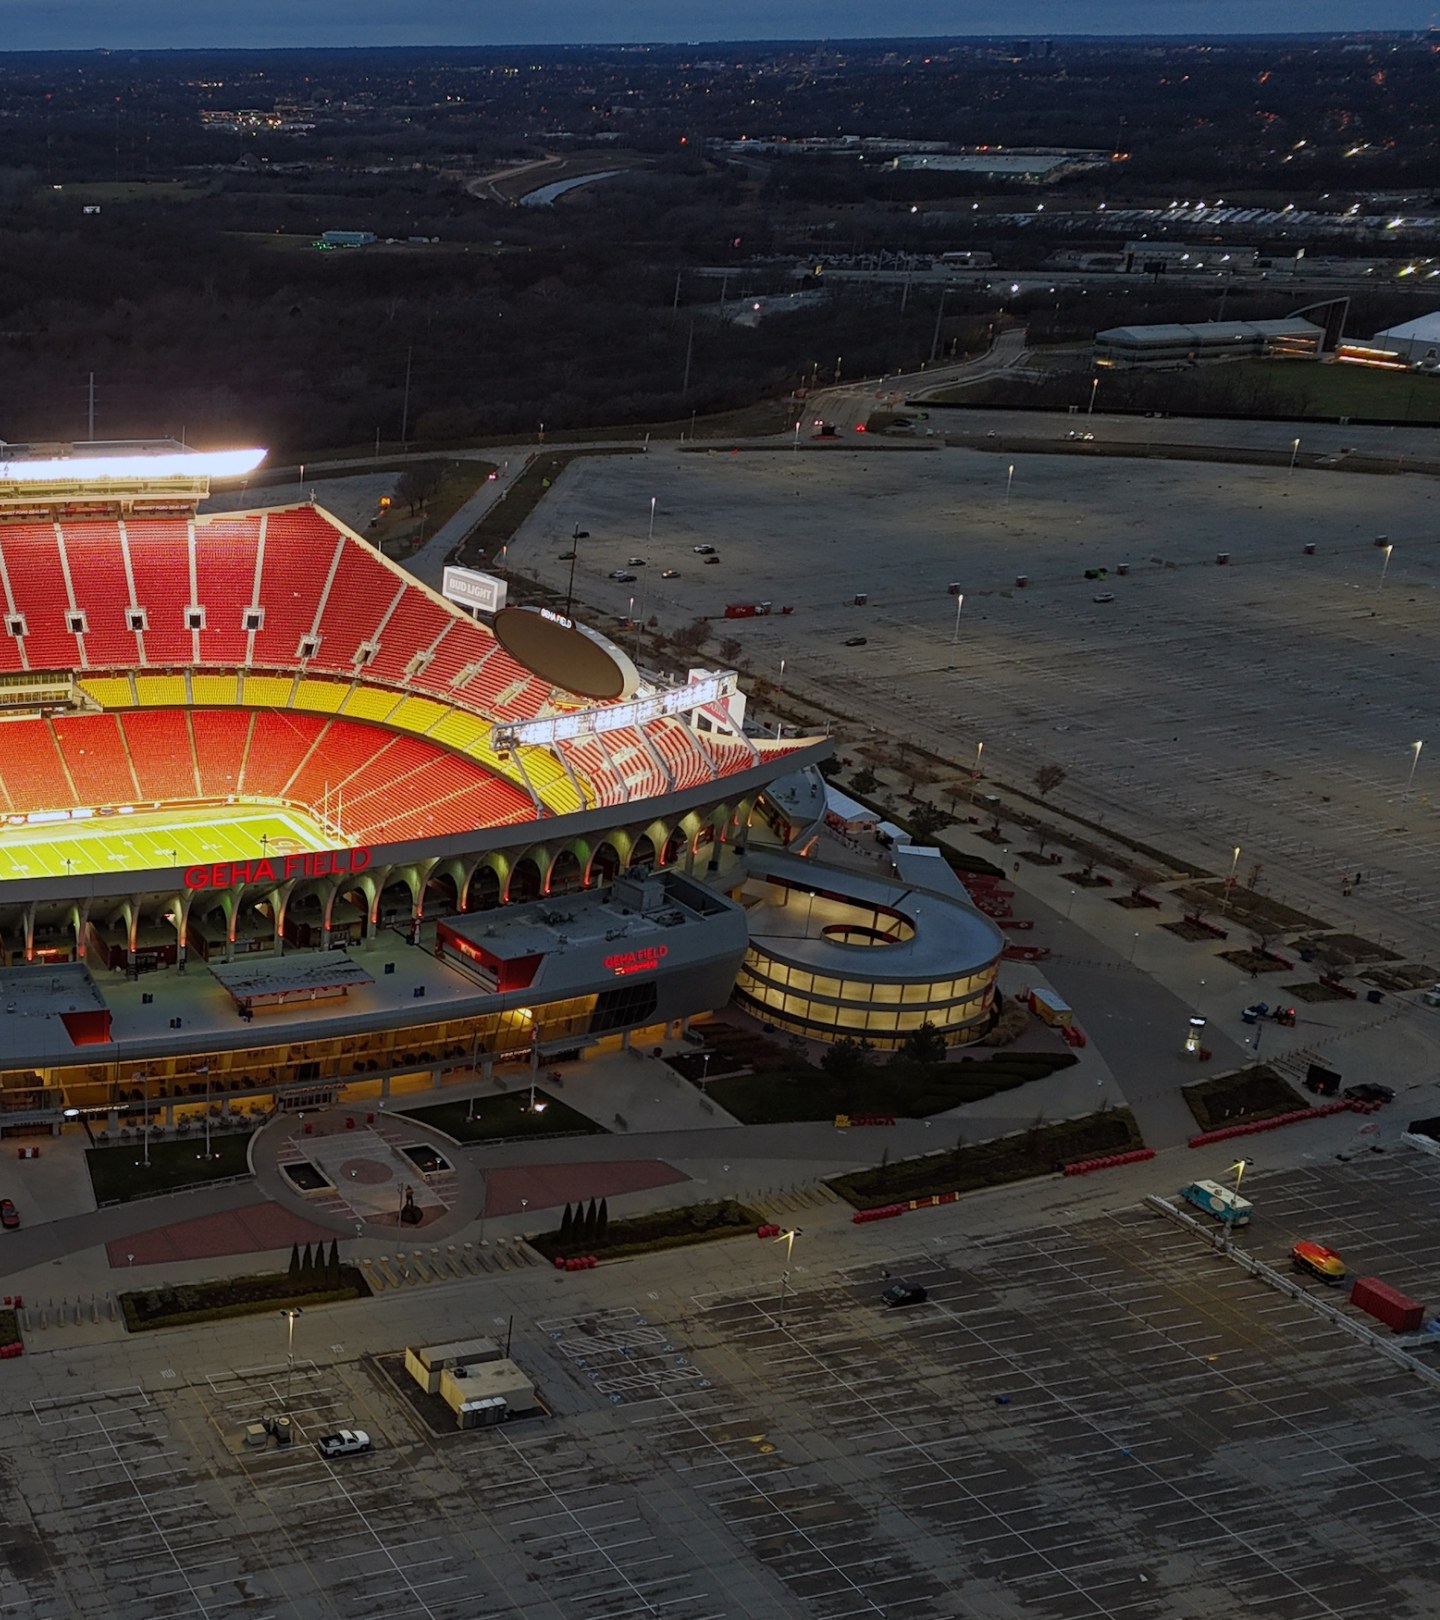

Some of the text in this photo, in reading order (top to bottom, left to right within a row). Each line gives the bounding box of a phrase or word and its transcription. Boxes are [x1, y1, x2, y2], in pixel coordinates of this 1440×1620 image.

[449, 578, 492, 600] BUD LIGHT
[541, 608, 572, 629] GEHA FIELD
[184, 847, 372, 890] GEHA FIELD
[603, 952, 635, 969] GEHA
[637, 945, 668, 960] FIELD
